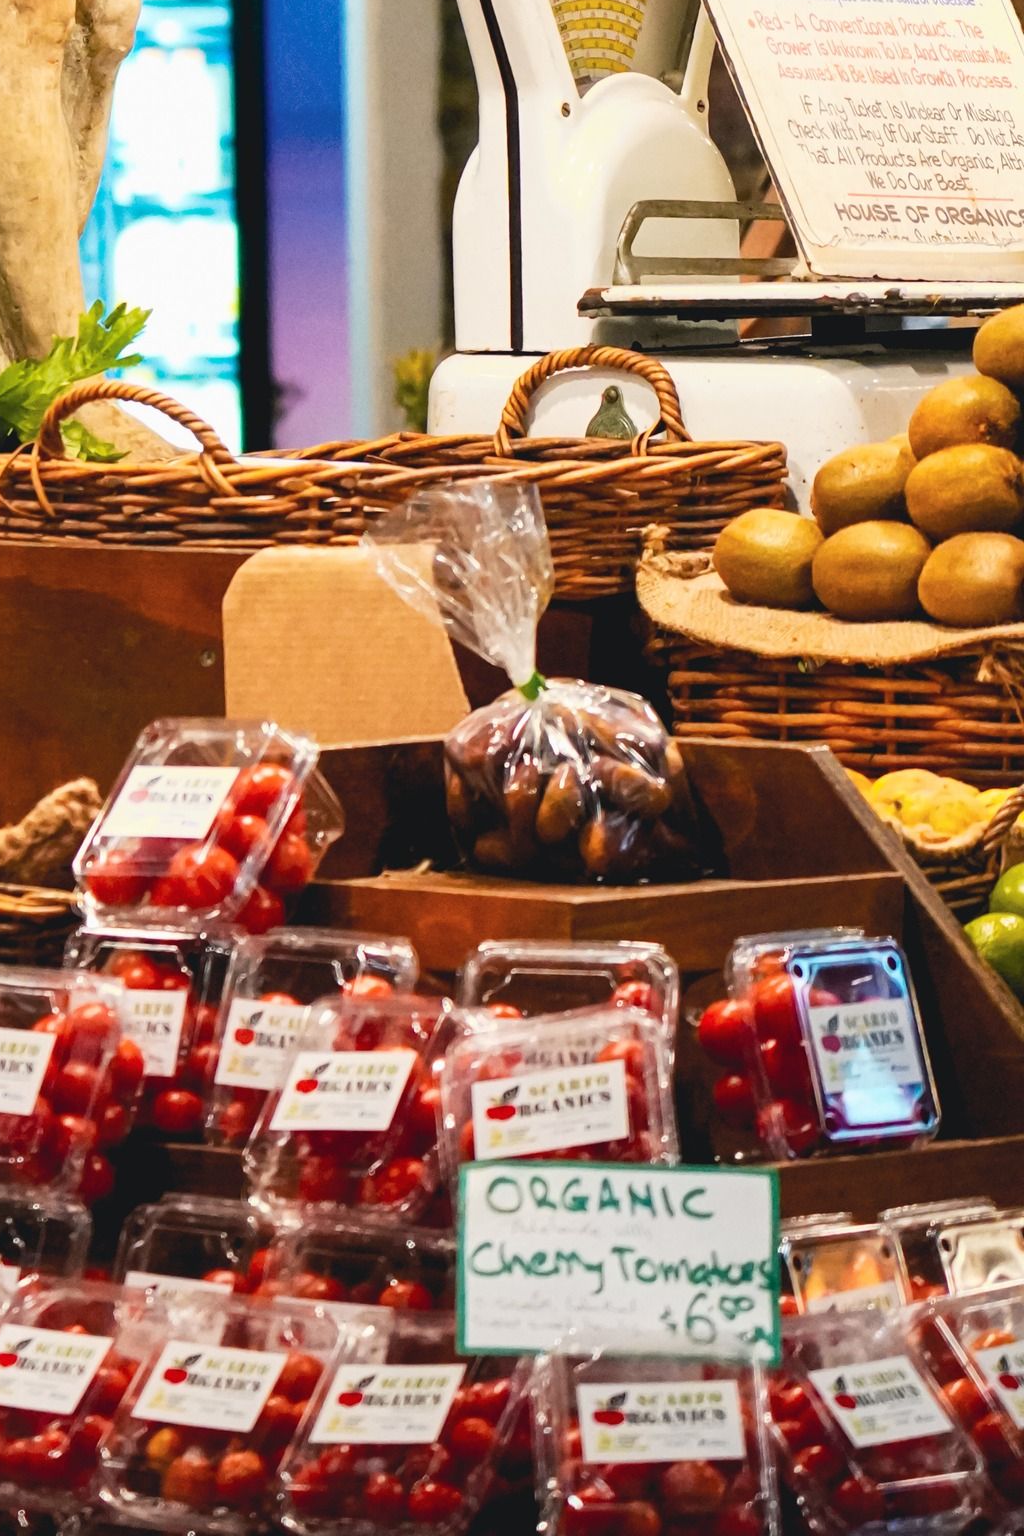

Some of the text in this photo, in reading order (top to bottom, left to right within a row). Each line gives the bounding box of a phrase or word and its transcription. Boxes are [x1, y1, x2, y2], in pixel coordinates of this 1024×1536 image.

[794, 13, 807, 31] A
[809, 13, 899, 37] Conventional
[955, 19, 985, 40] The
[765, 36, 812, 56] Grower
[814, 40, 828, 56] Is
[826, 39, 878, 60] Unknown
[877, 41, 893, 60] To
[914, 43, 940, 62] And
[938, 43, 994, 64] Chemicals
[992, 45, 1013, 64] Are
[776, 61, 1018, 89] Assumed To Be Used In Growth Process.
[818, 96, 848, 123] Any
[844, 97, 888, 120] Ticket
[886, 100, 898, 120] Is
[899, 100, 946, 121] Unclear
[947, 102, 963, 122] Or
[963, 102, 1016, 129] Missing
[787, 119, 830, 140] Check
[828, 120, 858, 141] With
[857, 122, 885, 147] Any
[898, 123, 921, 144] Our
[966, 127, 986, 146] Do
[984, 128, 1010, 147] Not
[796, 143, 835, 165] That
[836, 145, 857, 165] All
[855, 147, 917, 168] Products
[917, 149, 943, 168] Are
[941, 150, 1001, 175] Organic,
[865, 170, 979, 191] We Do Our Best.
[834, 202, 901, 223] HOUSE
[905, 205, 930, 224] OF
[486, 1176, 714, 1219] ORGANIC
[472, 1242, 605, 1295] Cherry
